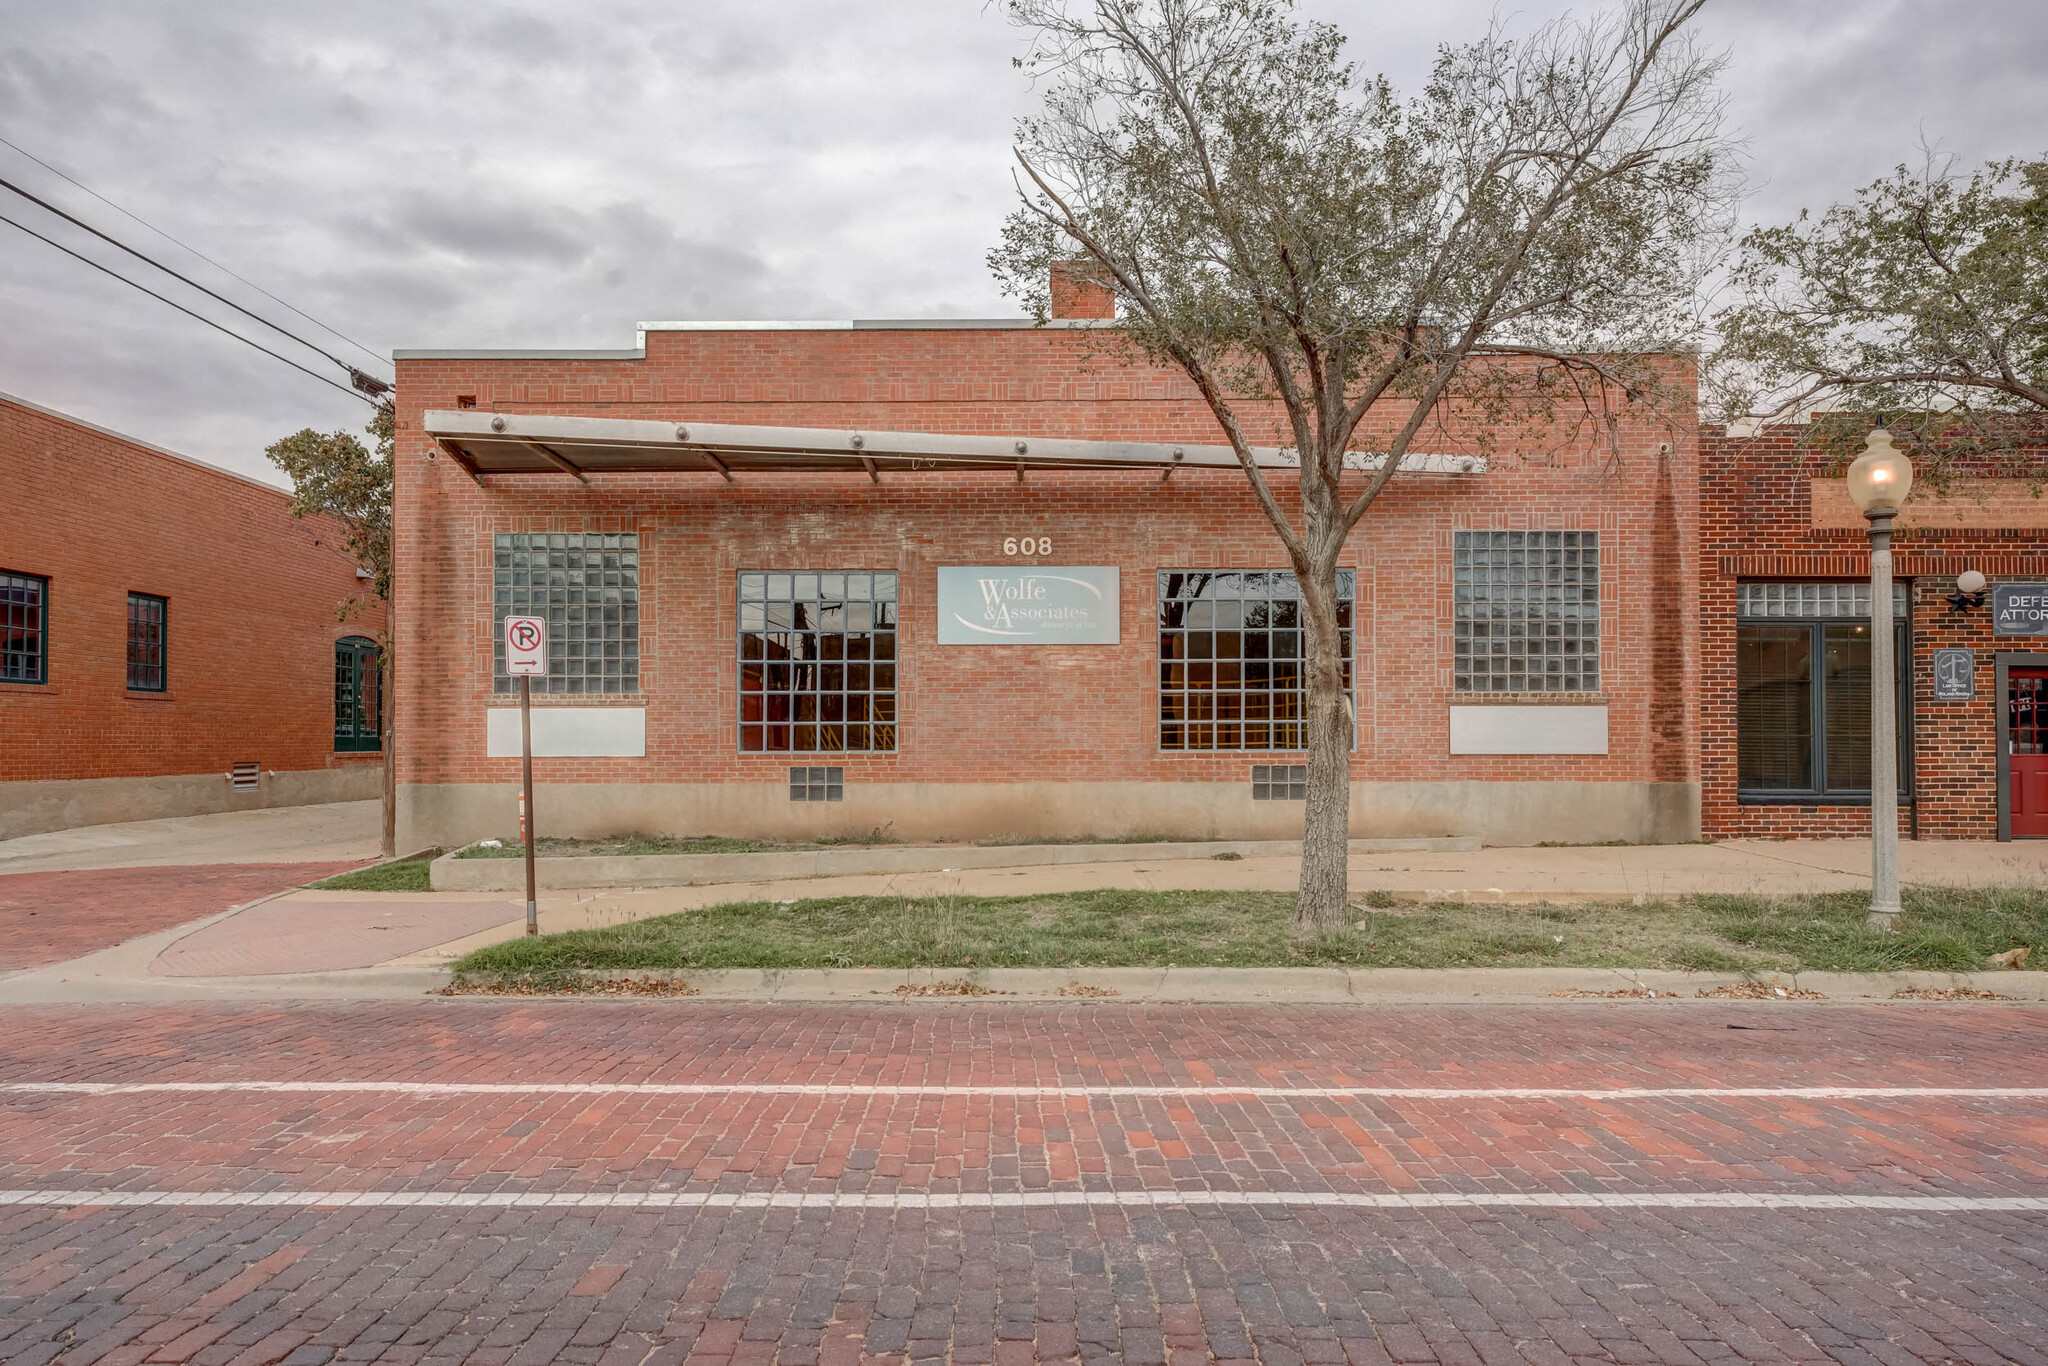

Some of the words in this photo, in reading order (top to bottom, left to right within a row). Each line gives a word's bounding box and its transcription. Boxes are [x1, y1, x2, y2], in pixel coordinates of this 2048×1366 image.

[1003, 536, 1053, 556] 608
[977, 578, 1047, 606] Wolfe
[2009, 596, 2048, 607] DEFE
[1999, 609, 2048, 621] ATTOR
